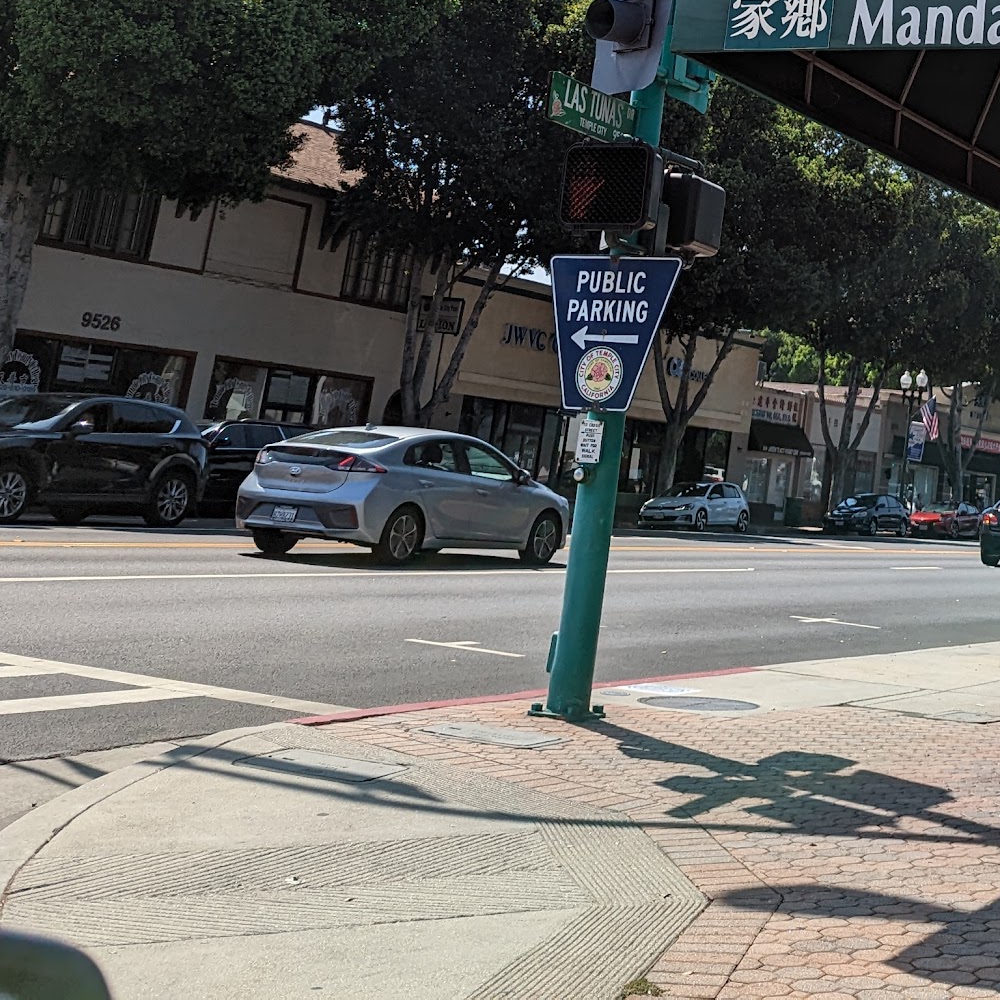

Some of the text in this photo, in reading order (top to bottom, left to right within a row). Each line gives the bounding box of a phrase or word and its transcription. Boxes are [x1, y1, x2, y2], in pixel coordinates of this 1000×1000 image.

[564, 79, 635, 128] LAS TUNAS DR
[580, 117, 598, 133] TEMPLE
[597, 124, 608, 136] CITY
[576, 270, 646, 294] PUBLIC
[81, 311, 122, 331] 9526
[566, 299, 649, 324] PARKING
[579, 362, 587, 378] CITY
[586, 353, 594, 361] OF
[596, 350, 617, 363] TEMPLE
[581, 384, 614, 398] CALIFORNIA
